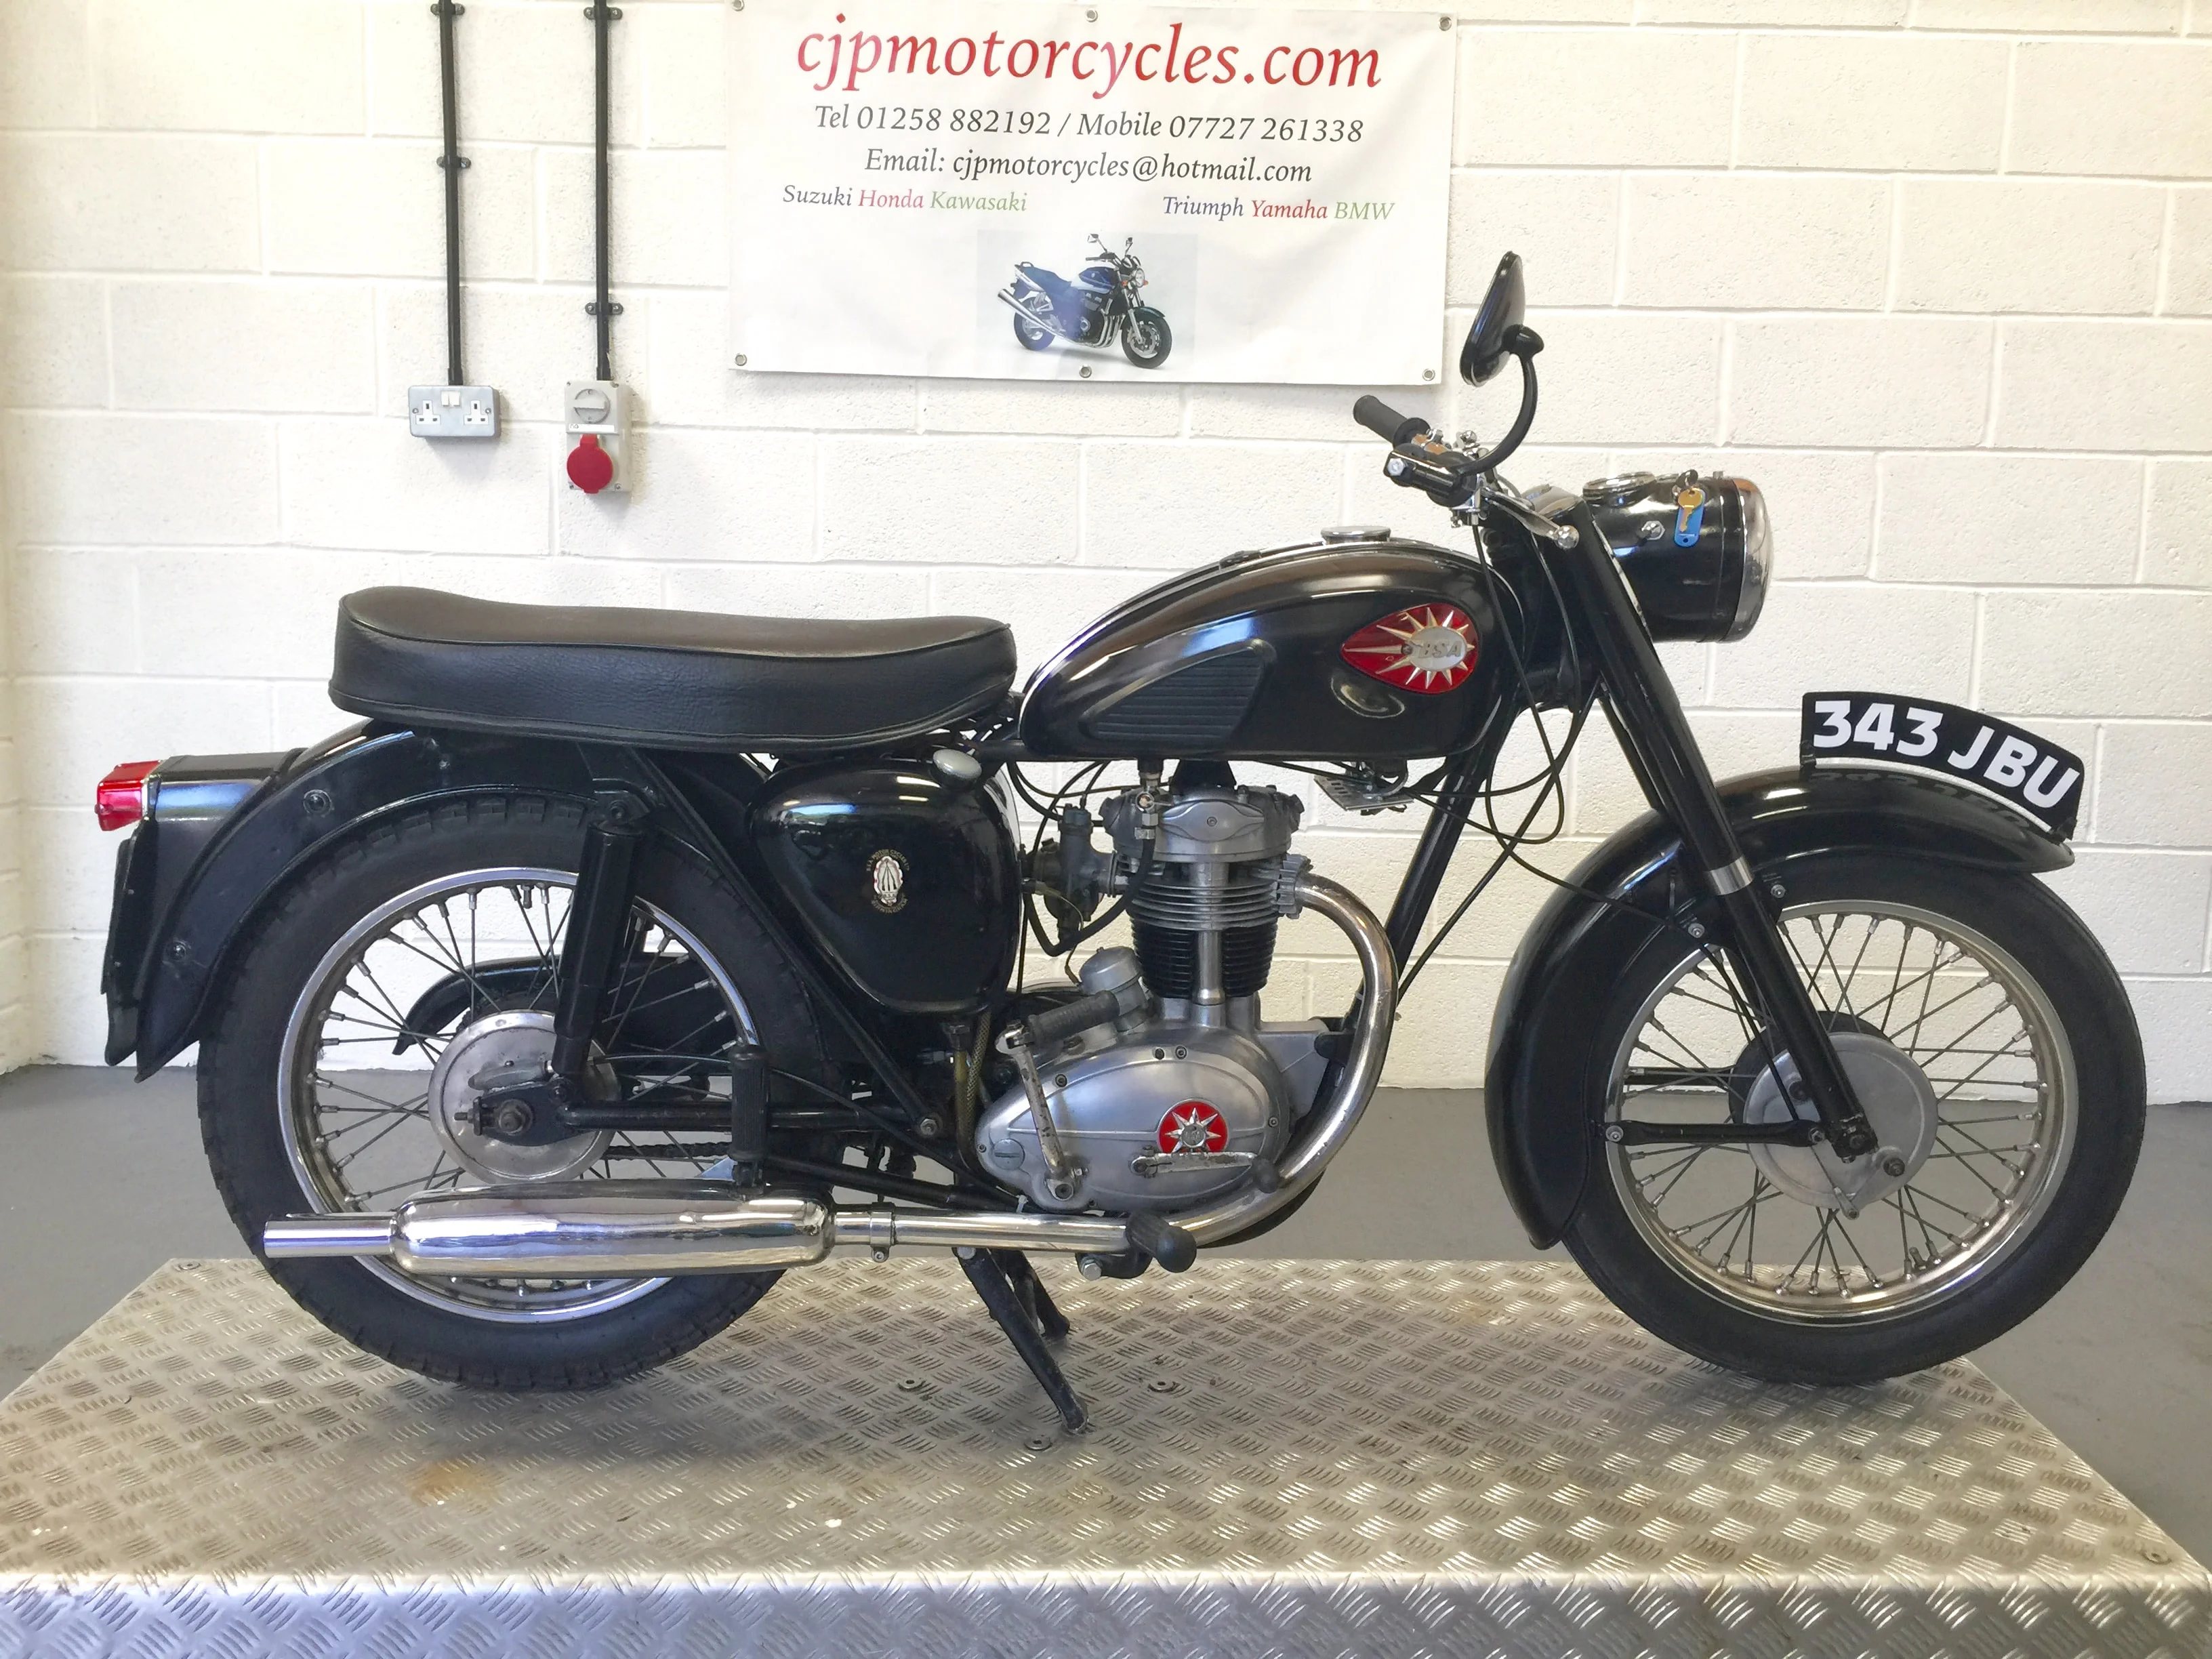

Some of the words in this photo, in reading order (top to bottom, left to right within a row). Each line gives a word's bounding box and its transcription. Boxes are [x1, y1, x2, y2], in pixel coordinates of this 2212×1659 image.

[798, 12, 1381, 99] cjpmotorcycles.com
[815, 104, 848, 128] Tel
[857, 106, 941, 131] 01258
[950, 109, 1050, 134] 882192
[1057, 113, 1071, 137] /
[1077, 111, 1162, 136] Mobile
[1170, 116, 1255, 140] 07727
[1261, 118, 1363, 142] 261338
[865, 148, 944, 171] Email:
[954, 149, 1311, 183] cjpmotorcycles@hotmail.com
[783, 185, 853, 206] Suzuki
[858, 189, 923, 208] Honda
[930, 191, 1027, 211] Kawasaki
[1164, 196, 1243, 221] Triumph
[1252, 199, 1328, 218] Yamaha
[1335, 202, 1395, 220] BMW
[1418, 640, 1462, 658] BSA
[1814, 699, 1944, 757] 343
[1948, 726, 2080, 808] JBU
